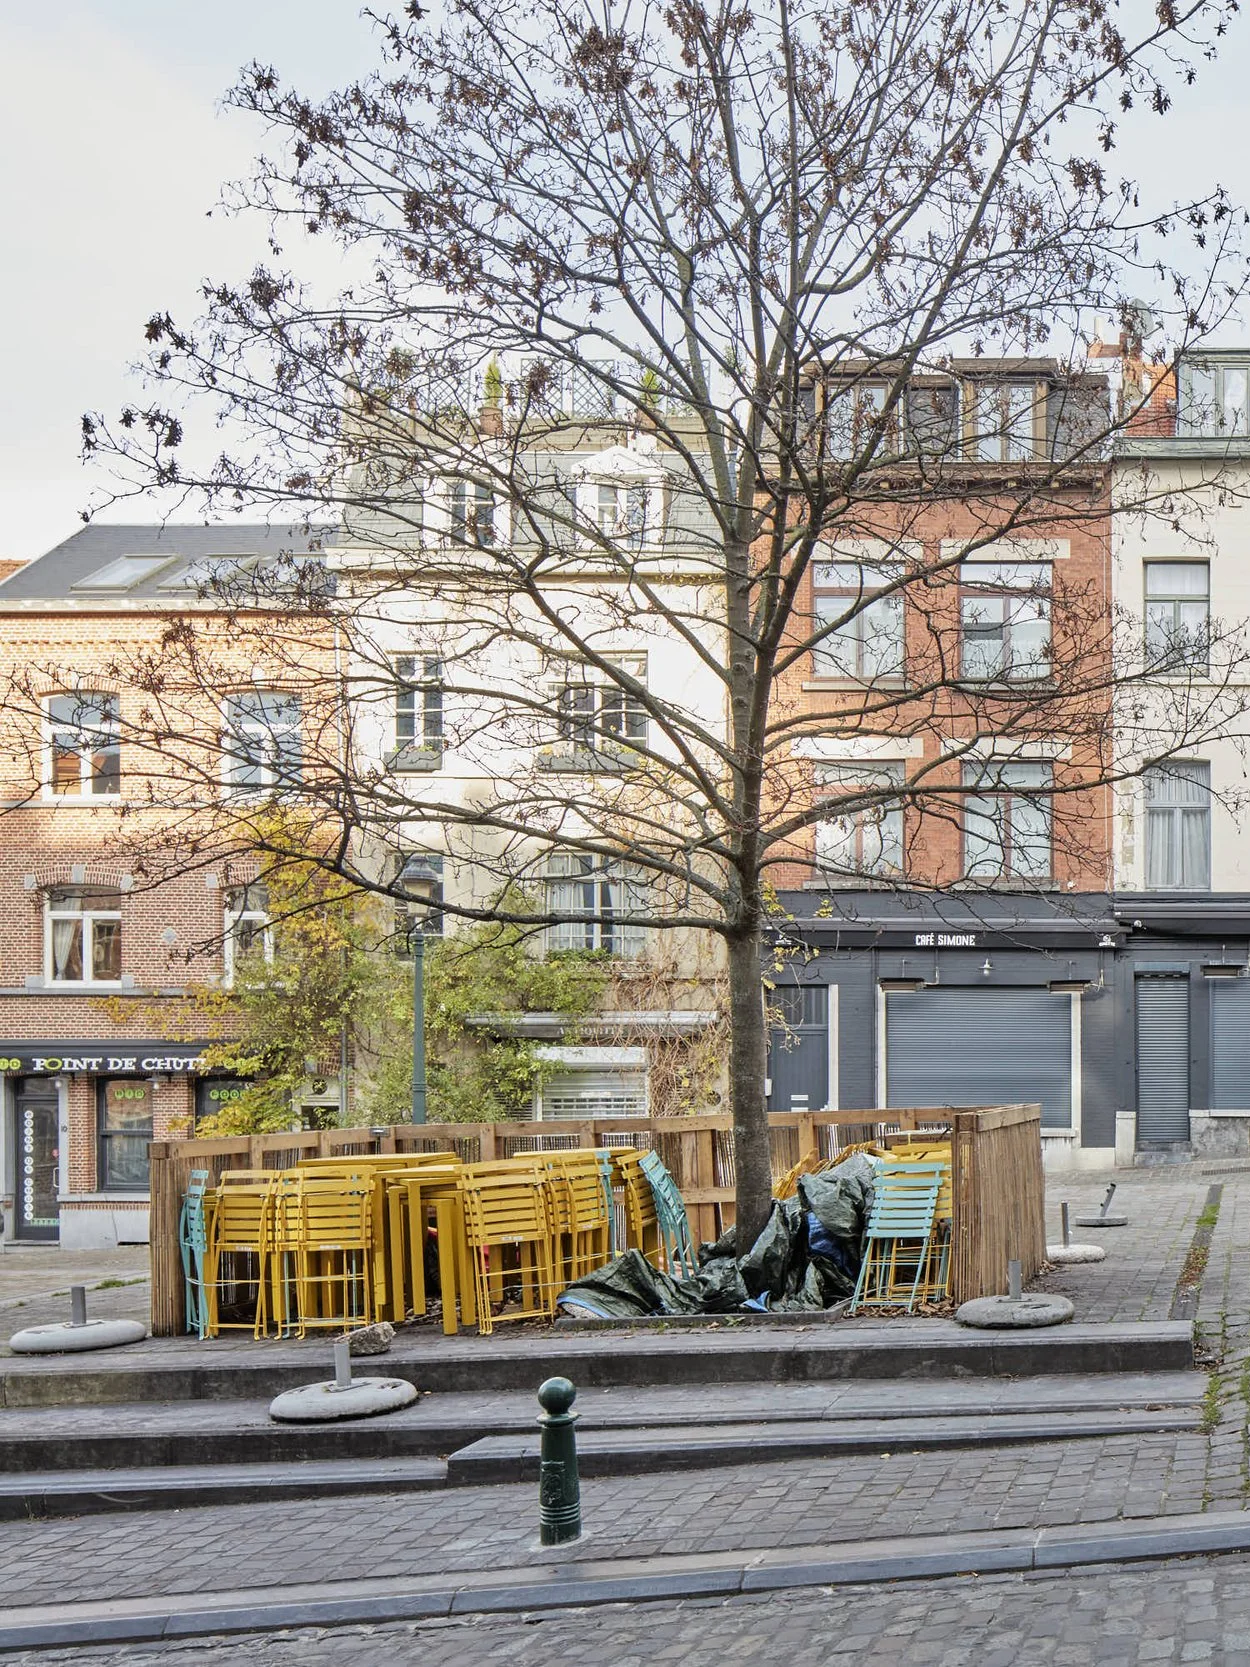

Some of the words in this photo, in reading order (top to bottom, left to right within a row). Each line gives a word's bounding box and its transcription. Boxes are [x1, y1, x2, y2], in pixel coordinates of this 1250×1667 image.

[915, 932, 934, 946] CAFÉ
[937, 934, 976, 946] SIMONE
[32, 1057, 103, 1071] POINT
[107, 1057, 137, 1071] DE
